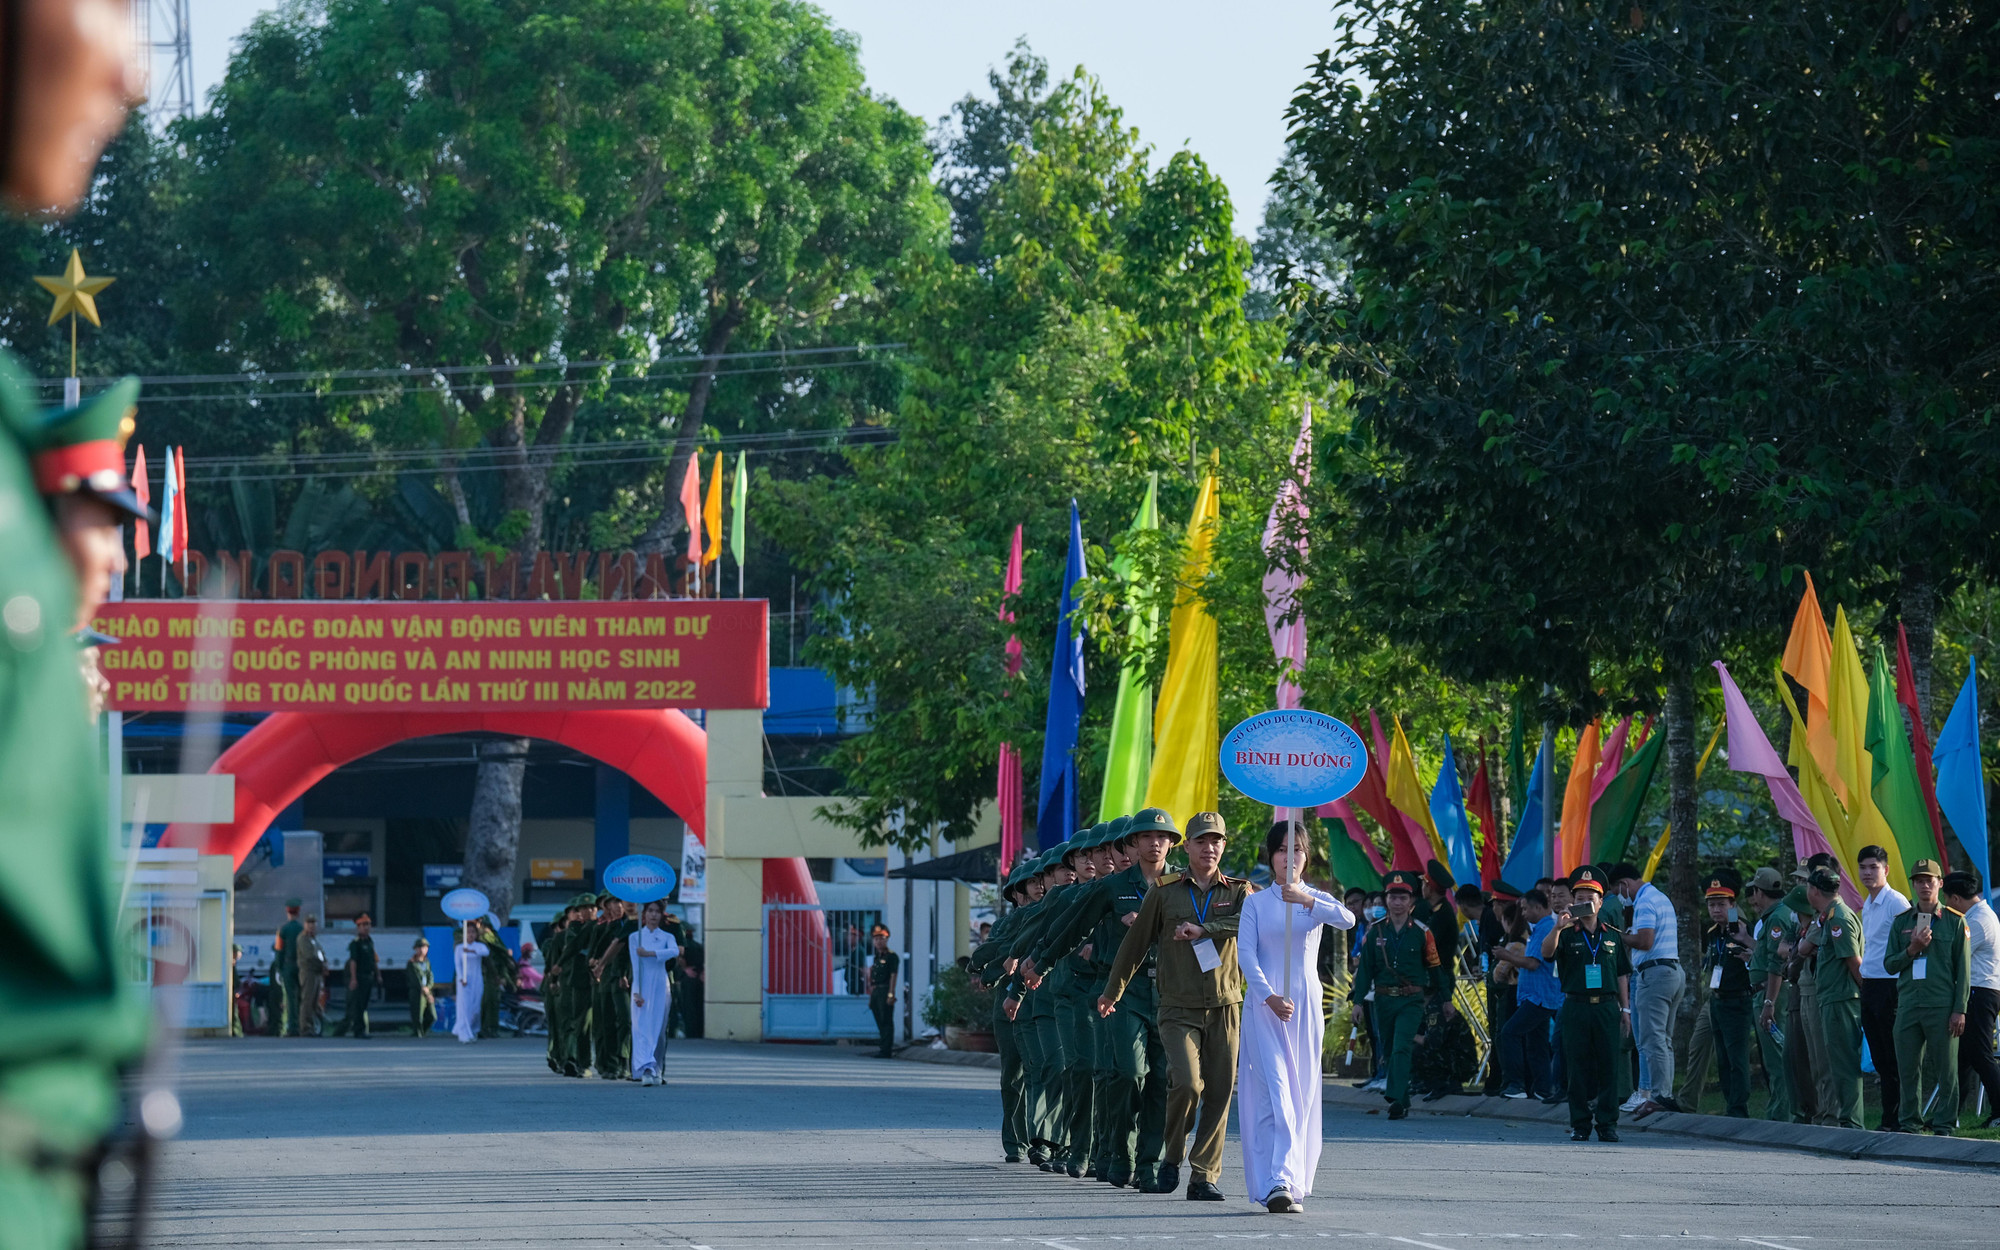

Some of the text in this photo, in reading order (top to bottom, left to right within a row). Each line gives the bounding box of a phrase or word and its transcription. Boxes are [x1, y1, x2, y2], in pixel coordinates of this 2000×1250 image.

[91, 614, 160, 638] CHÀO
[169, 615, 246, 638] MỪNG
[254, 616, 305, 640] CÁC
[313, 615, 383, 639] ĐOÀN
[392, 615, 443, 641] VẬN
[451, 614, 521, 641] ĐỘNG
[529, 614, 587, 637] VIÊN
[595, 617, 666, 637] THAM
[674, 614, 711, 639] DỰ
[104, 645, 680, 674] GIÁO DỤC QUỐC PHÒNG VÀ AN NINH HỌC SINH
[117, 675, 697, 704] PHỔ THÔNG TOÀN QUỐC LẦN THỨ III NĂM 2022
[1235, 748, 1352, 769] BÌNH DƯƠNG
